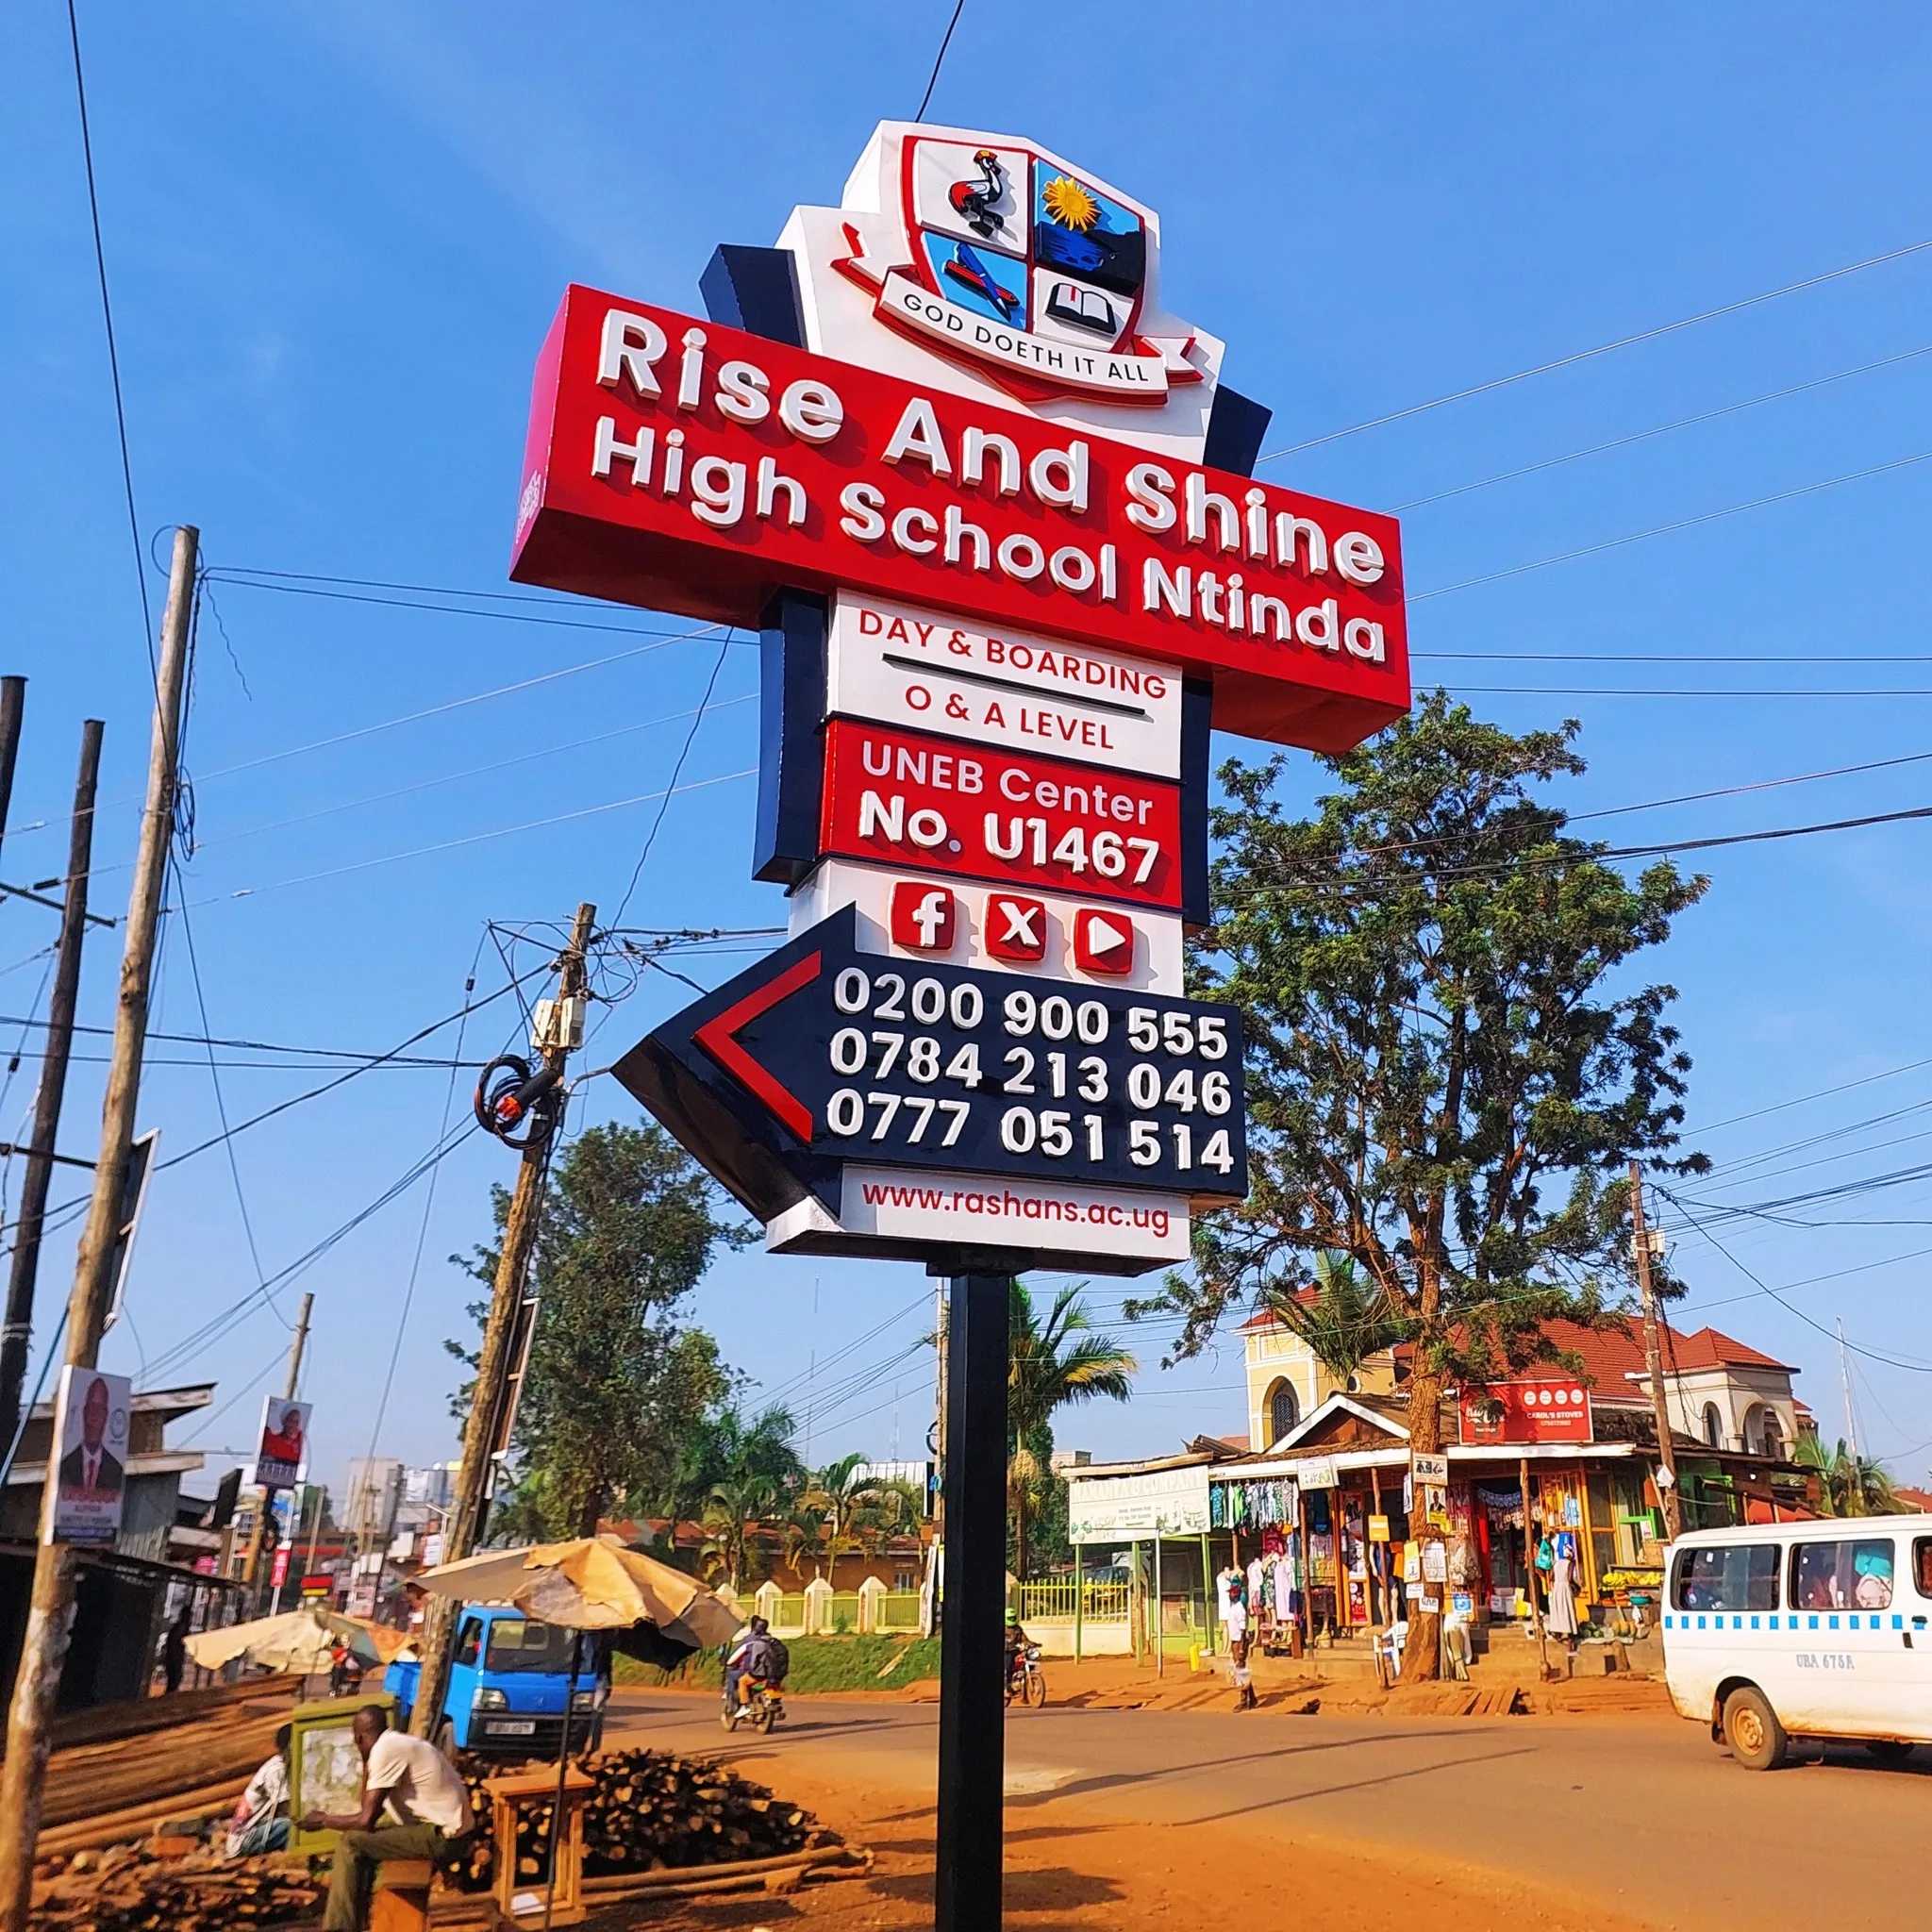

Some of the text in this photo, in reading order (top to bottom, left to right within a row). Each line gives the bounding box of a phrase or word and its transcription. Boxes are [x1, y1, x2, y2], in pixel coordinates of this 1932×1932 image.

[903, 293, 1149, 382] GOD DOETH IT ALL
[595, 308, 1385, 588] Rise And Shine
[591, 415, 808, 529] High
[839, 482, 1117, 604] School
[1142, 557, 1386, 663] Ntinda
[859, 608, 1167, 700] DAY & BOARDING
[905, 685, 1115, 751] O & A LEVEL
[861, 740, 1154, 825] UNEB Center
[858, 790, 1160, 885] No. U1467
[833, 966, 1227, 1061] 0200 900 555
[828, 1026, 1232, 1117] 0784 213 046
[825, 1088, 1235, 1174] 0777 051 514
[861, 1183, 1170, 1239] www.rashans.ac.ug
[1795, 1654, 1820, 1669] UBA
